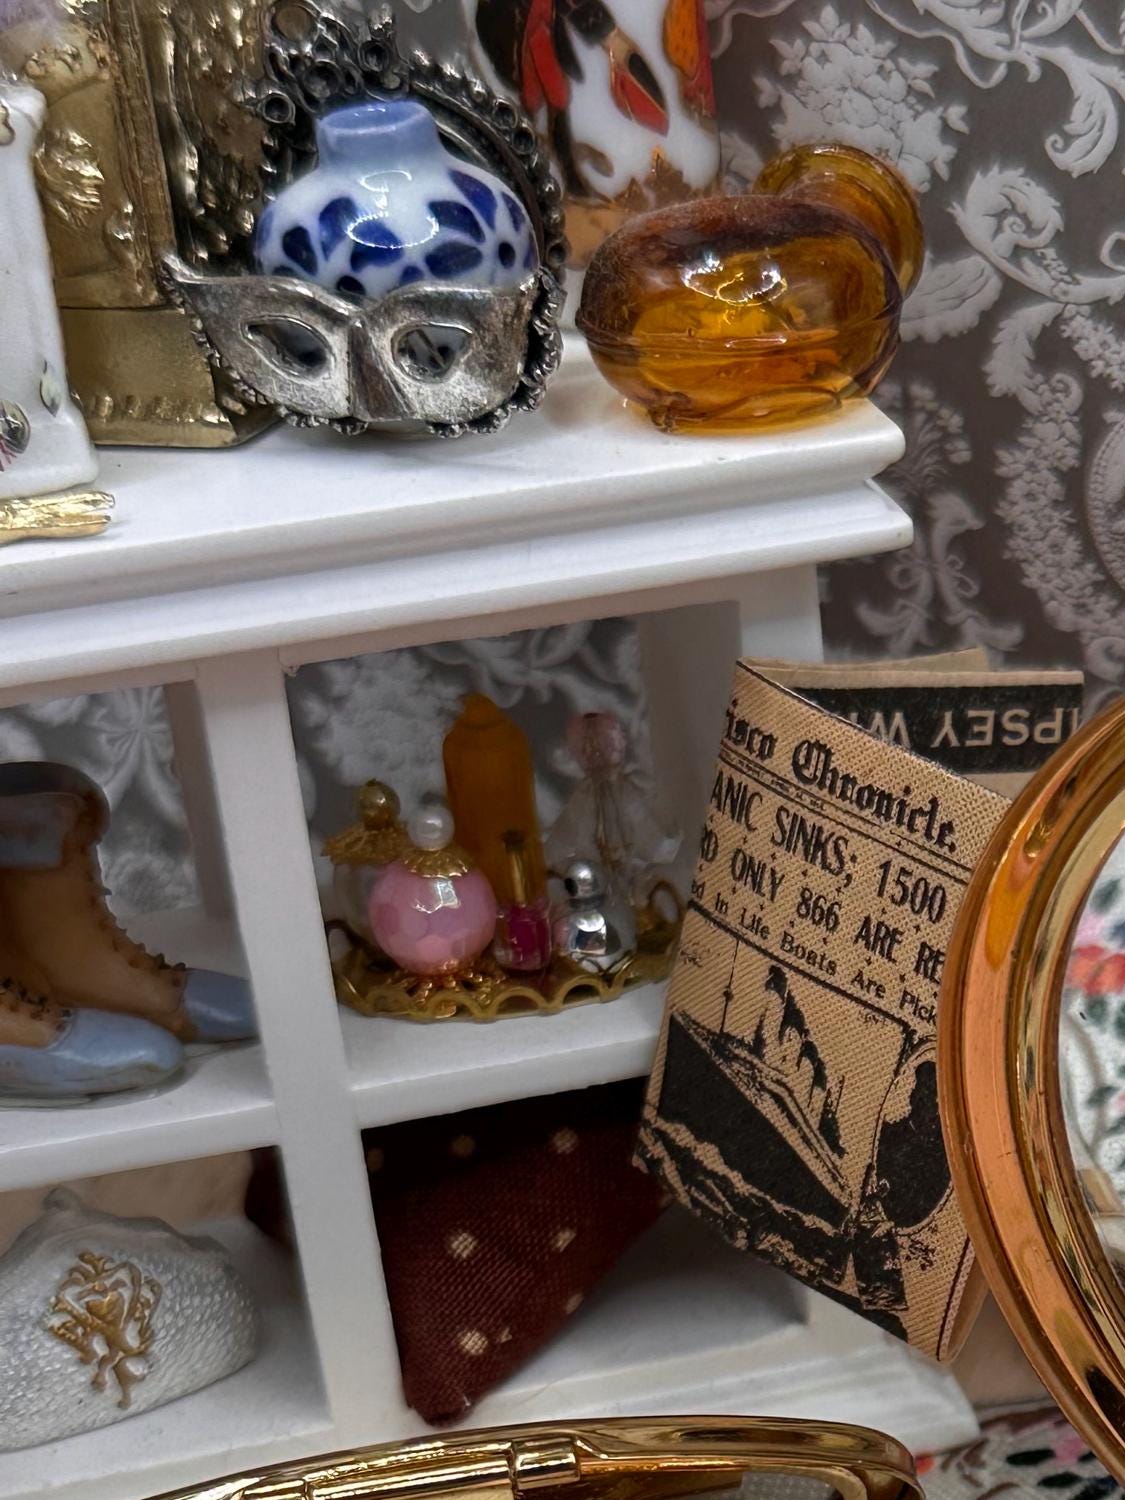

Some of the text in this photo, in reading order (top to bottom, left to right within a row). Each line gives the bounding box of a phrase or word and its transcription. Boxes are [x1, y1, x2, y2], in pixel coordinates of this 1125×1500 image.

[731, 848, 786, 903] ONLY
[796, 886, 842, 933] 866
[853, 914, 905, 964] ARE
[770, 805, 857, 888] SINKS;
[879, 859, 947, 924] 1500
[780, 930, 837, 976] Boats
[851, 968, 886, 999] Are
